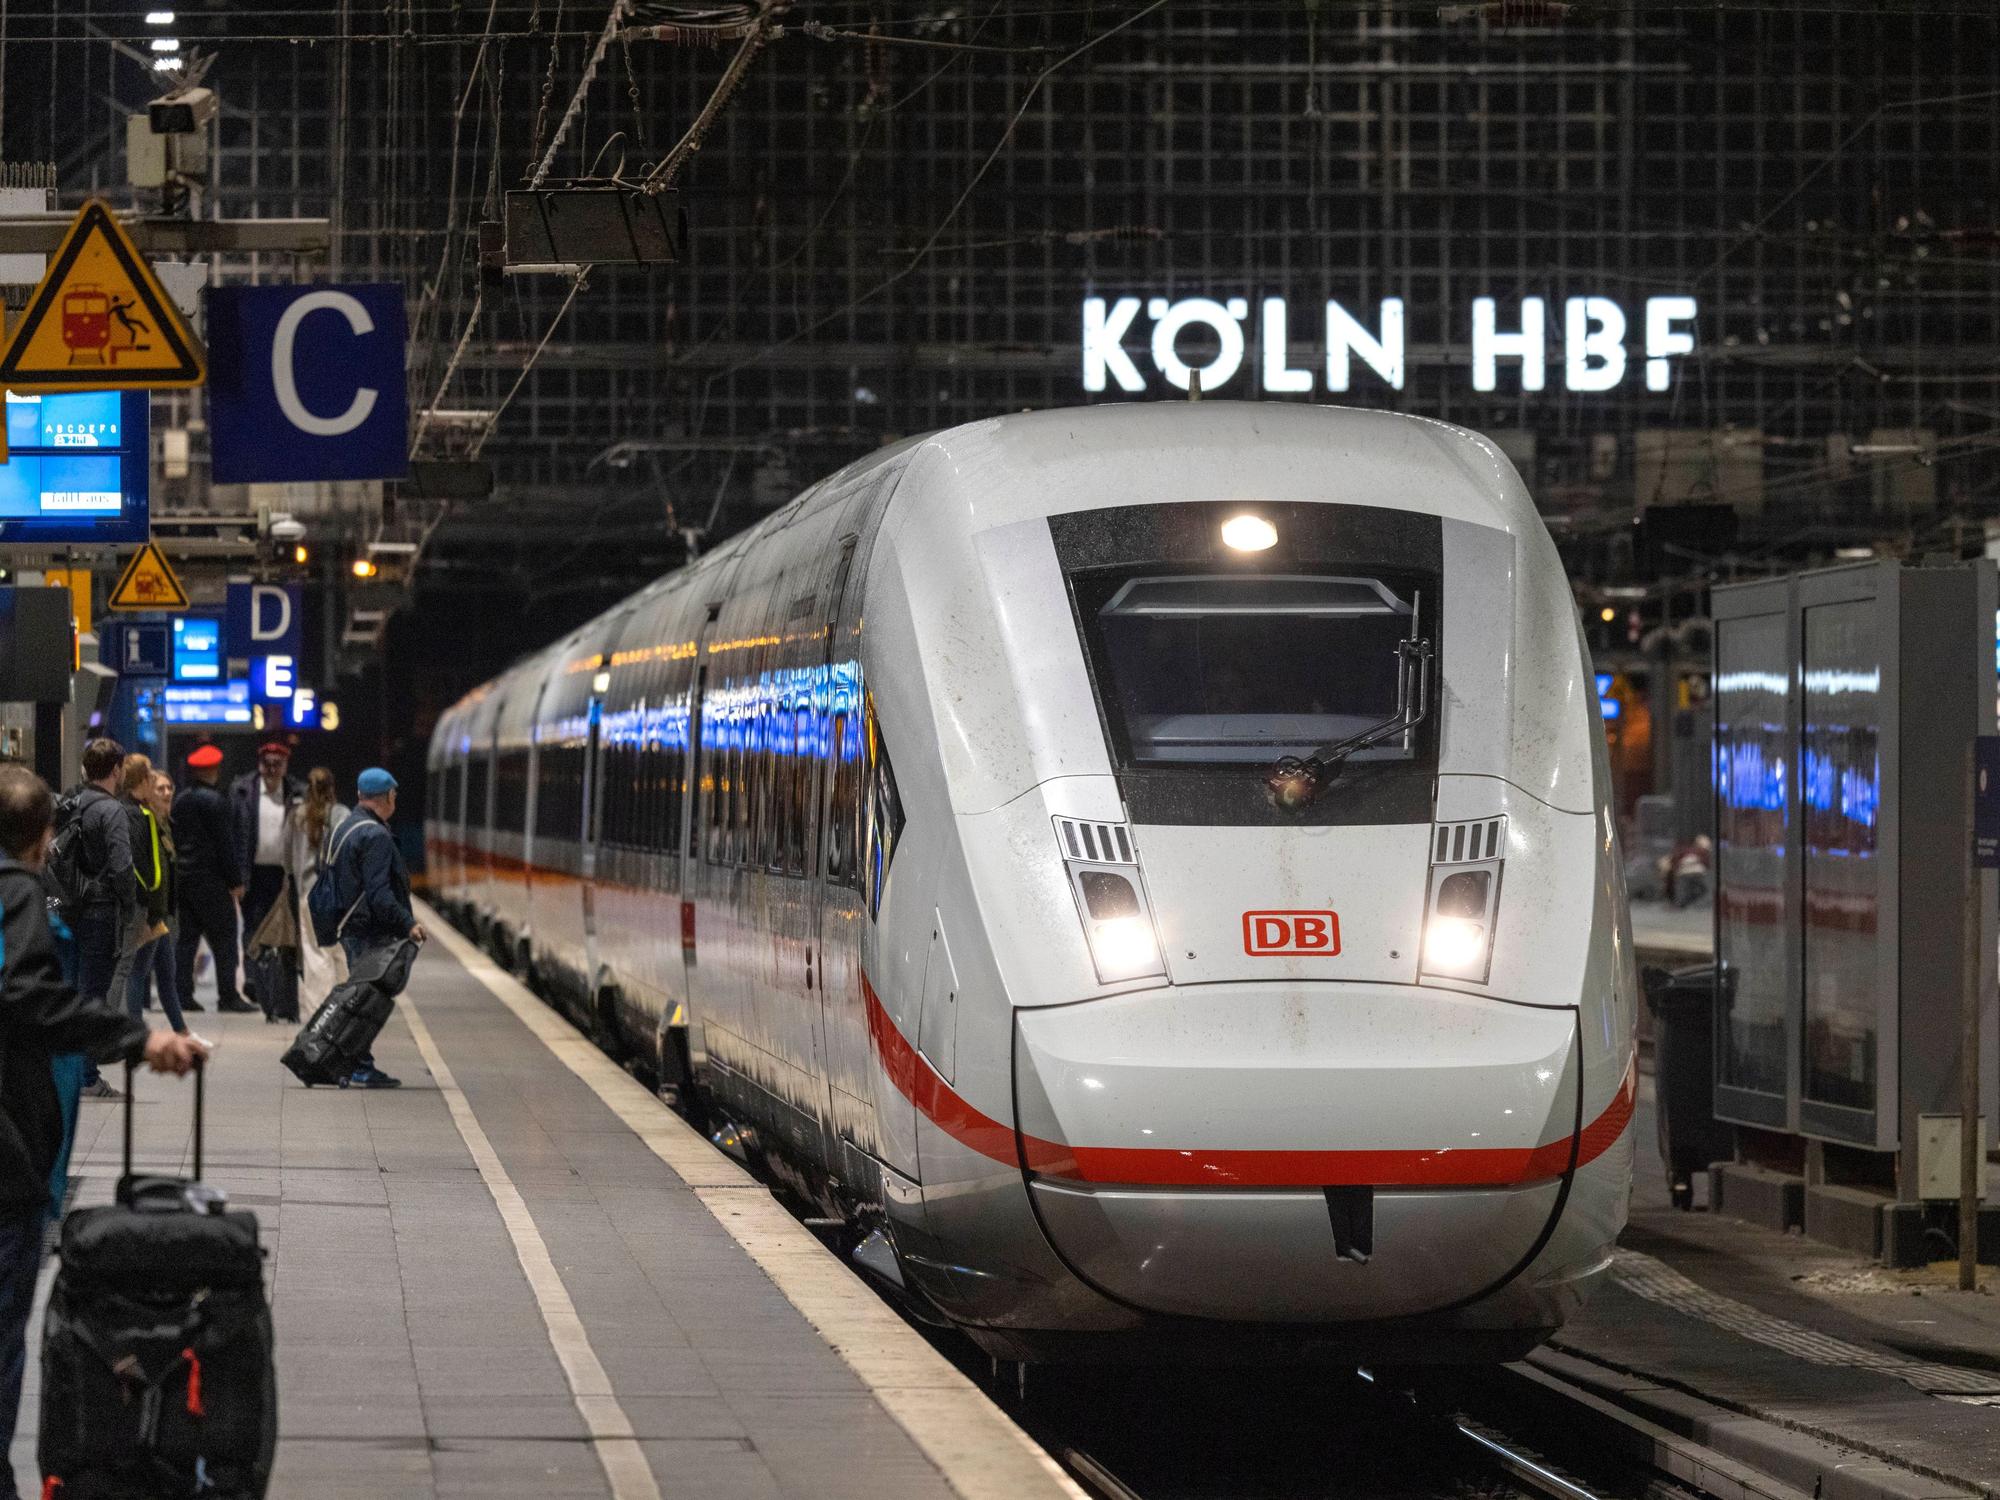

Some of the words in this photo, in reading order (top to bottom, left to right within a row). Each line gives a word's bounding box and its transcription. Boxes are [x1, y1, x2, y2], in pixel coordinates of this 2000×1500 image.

[271, 289, 379, 437] C
[1082, 297, 1405, 392] KÖLN
[1472, 297, 1698, 392] HBF
[251, 585, 291, 641] D
[265, 654, 293, 698] E
[293, 688, 315, 723] F
[321, 701, 339, 731] 3
[1254, 916, 1330, 950] DB
